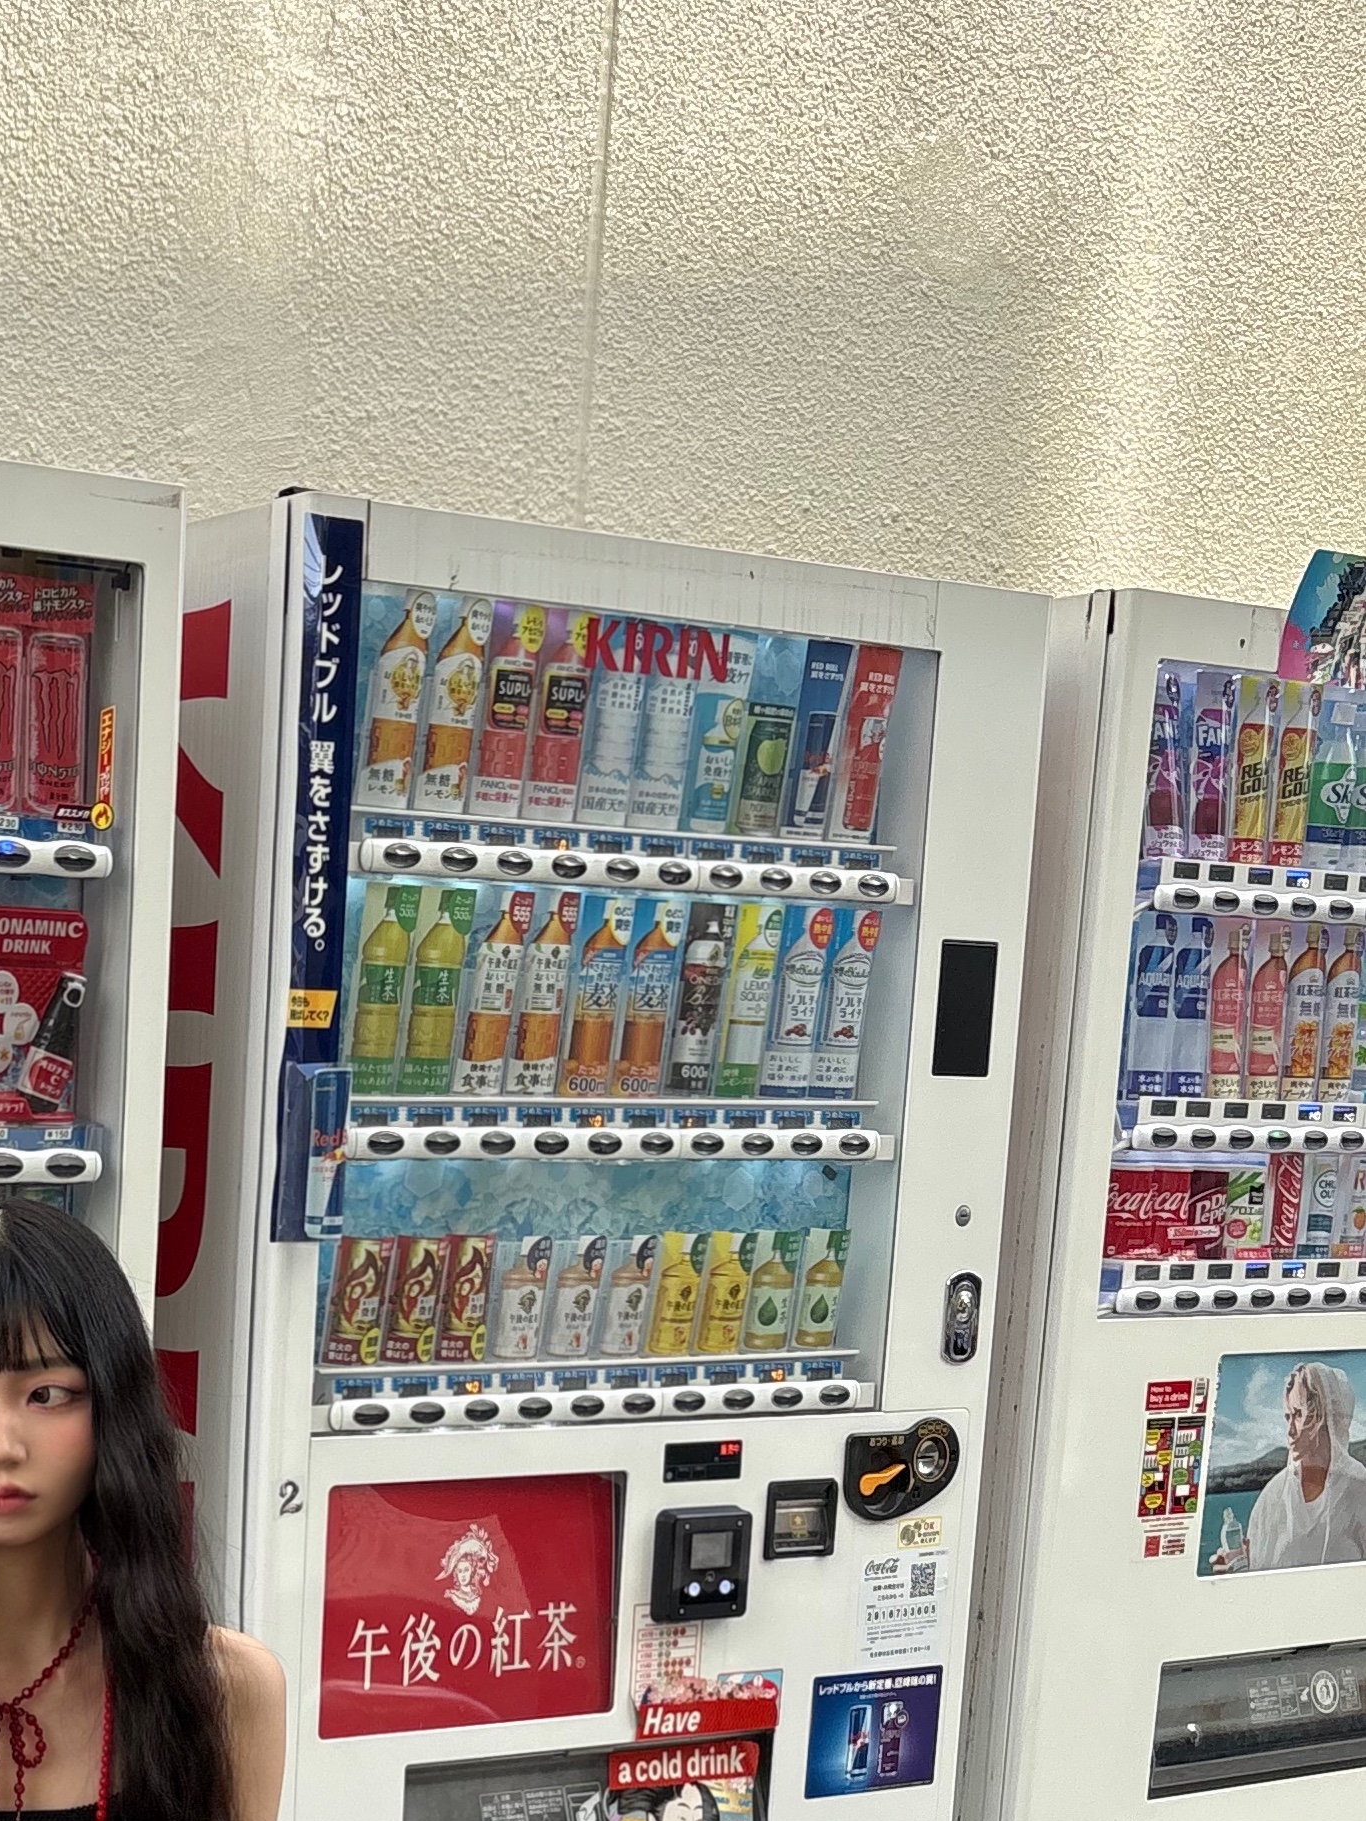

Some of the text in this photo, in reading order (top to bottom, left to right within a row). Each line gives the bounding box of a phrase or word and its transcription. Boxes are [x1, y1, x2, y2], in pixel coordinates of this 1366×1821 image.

[584, 616, 732, 683] KIRIN
[301, 558, 345, 952] レッドブル 翼をさずける。
[368, 768, 394, 783] 無糖
[425, 773, 451, 787] 無糖
[2, 938, 51, 955] DRINK
[279, 1480, 303, 1516] 2
[347, 1601, 578, 1691] 午後の紅茶
[643, 1706, 702, 1736] Have
[618, 1746, 746, 1785] a cold drink
